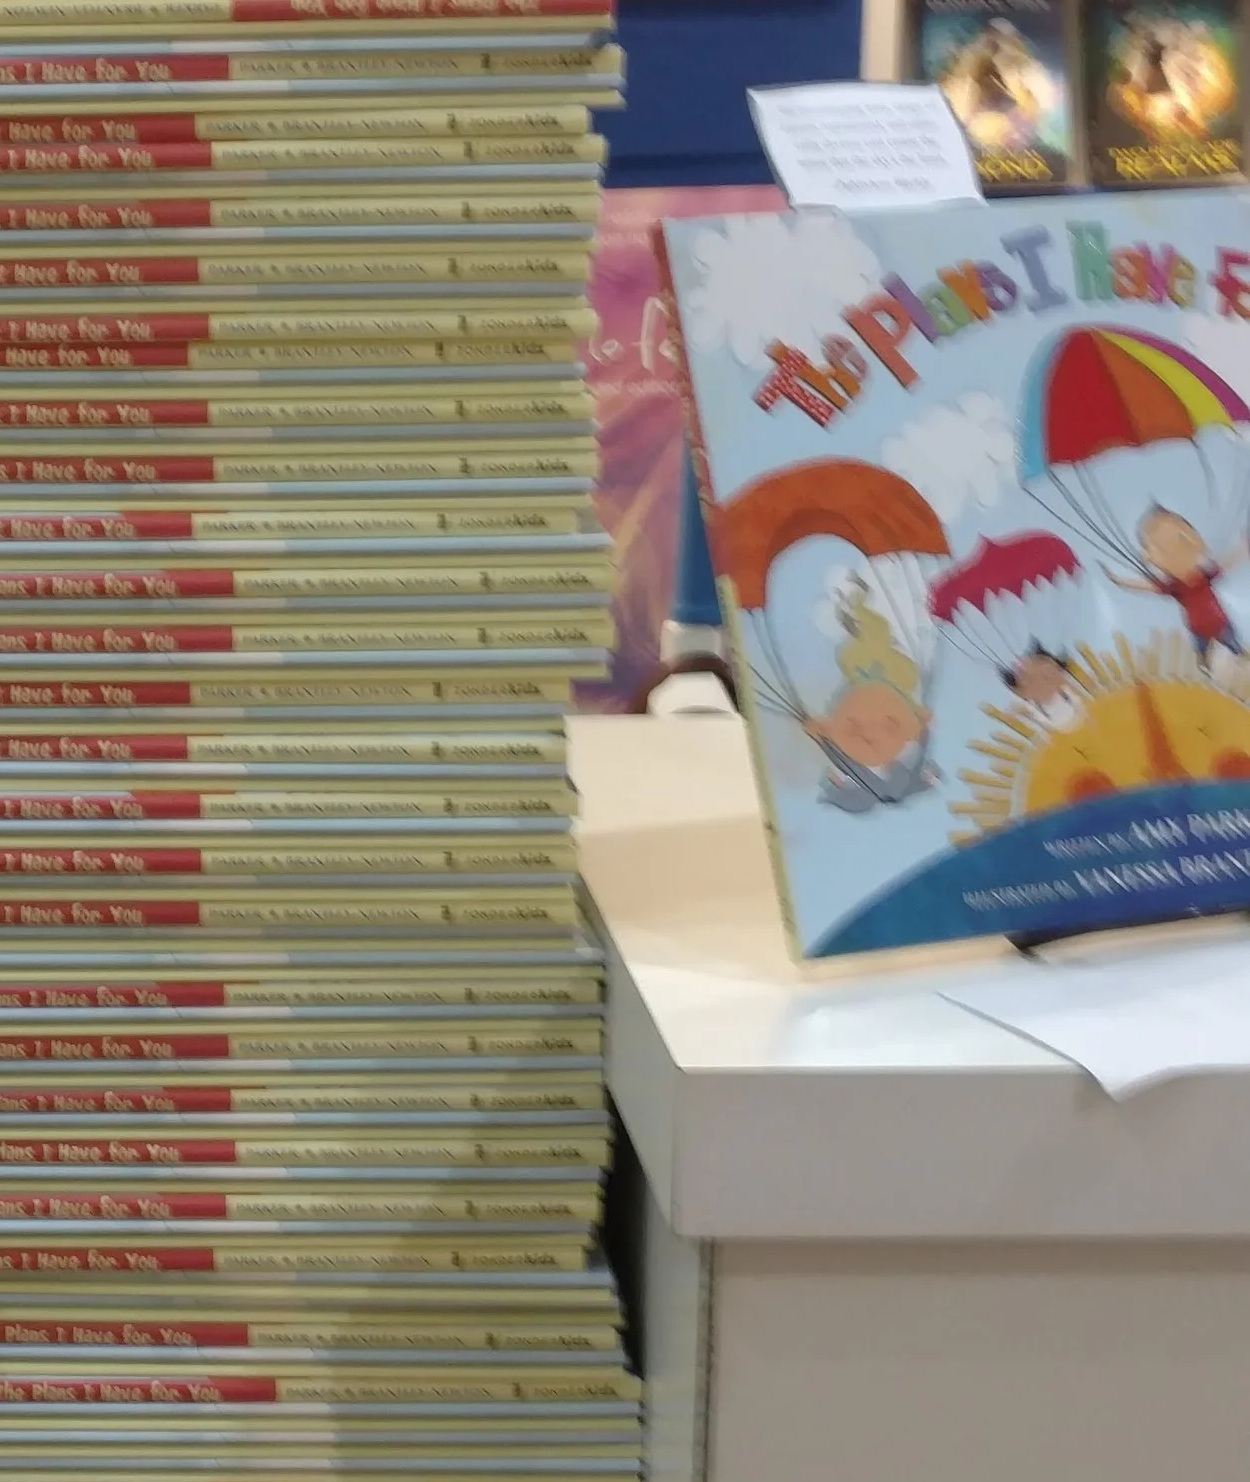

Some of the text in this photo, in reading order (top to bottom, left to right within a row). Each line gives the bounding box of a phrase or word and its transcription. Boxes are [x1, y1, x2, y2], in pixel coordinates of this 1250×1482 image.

[23, 58, 34, 85] I
[40, 57, 87, 84] Have
[94, 55, 126, 84] for
[135, 57, 171, 83] You
[7, 119, 54, 144] Have
[60, 116, 92, 143] for
[100, 119, 136, 143] You
[7, 146, 17, 172] I
[23, 146, 70, 172] Have
[76, 144, 109, 172] for
[117, 146, 154, 171] You
[7, 318, 19, 344] I
[24, 317, 69, 343] Have
[75, 315, 109, 343] for
[115, 318, 151, 343] You
[751, 333, 870, 428] The
[841, 259, 1020, 392] Plans
[999, 223, 1068, 314] I
[1064, 219, 1199, 308] Have
[15, 461, 25, 482] I
[31, 461, 77, 482] Have
[81, 459, 115, 482] for
[122, 462, 156, 482] You
[3, 904, 14, 926] I
[19, 904, 64, 926] Have
[69, 902, 102, 926] for
[109, 905, 143, 926] You
[41, 1143, 52, 1164] I
[56, 1143, 102, 1164] Have
[107, 1141, 139, 1164] for
[147, 1145, 181, 1165] You
